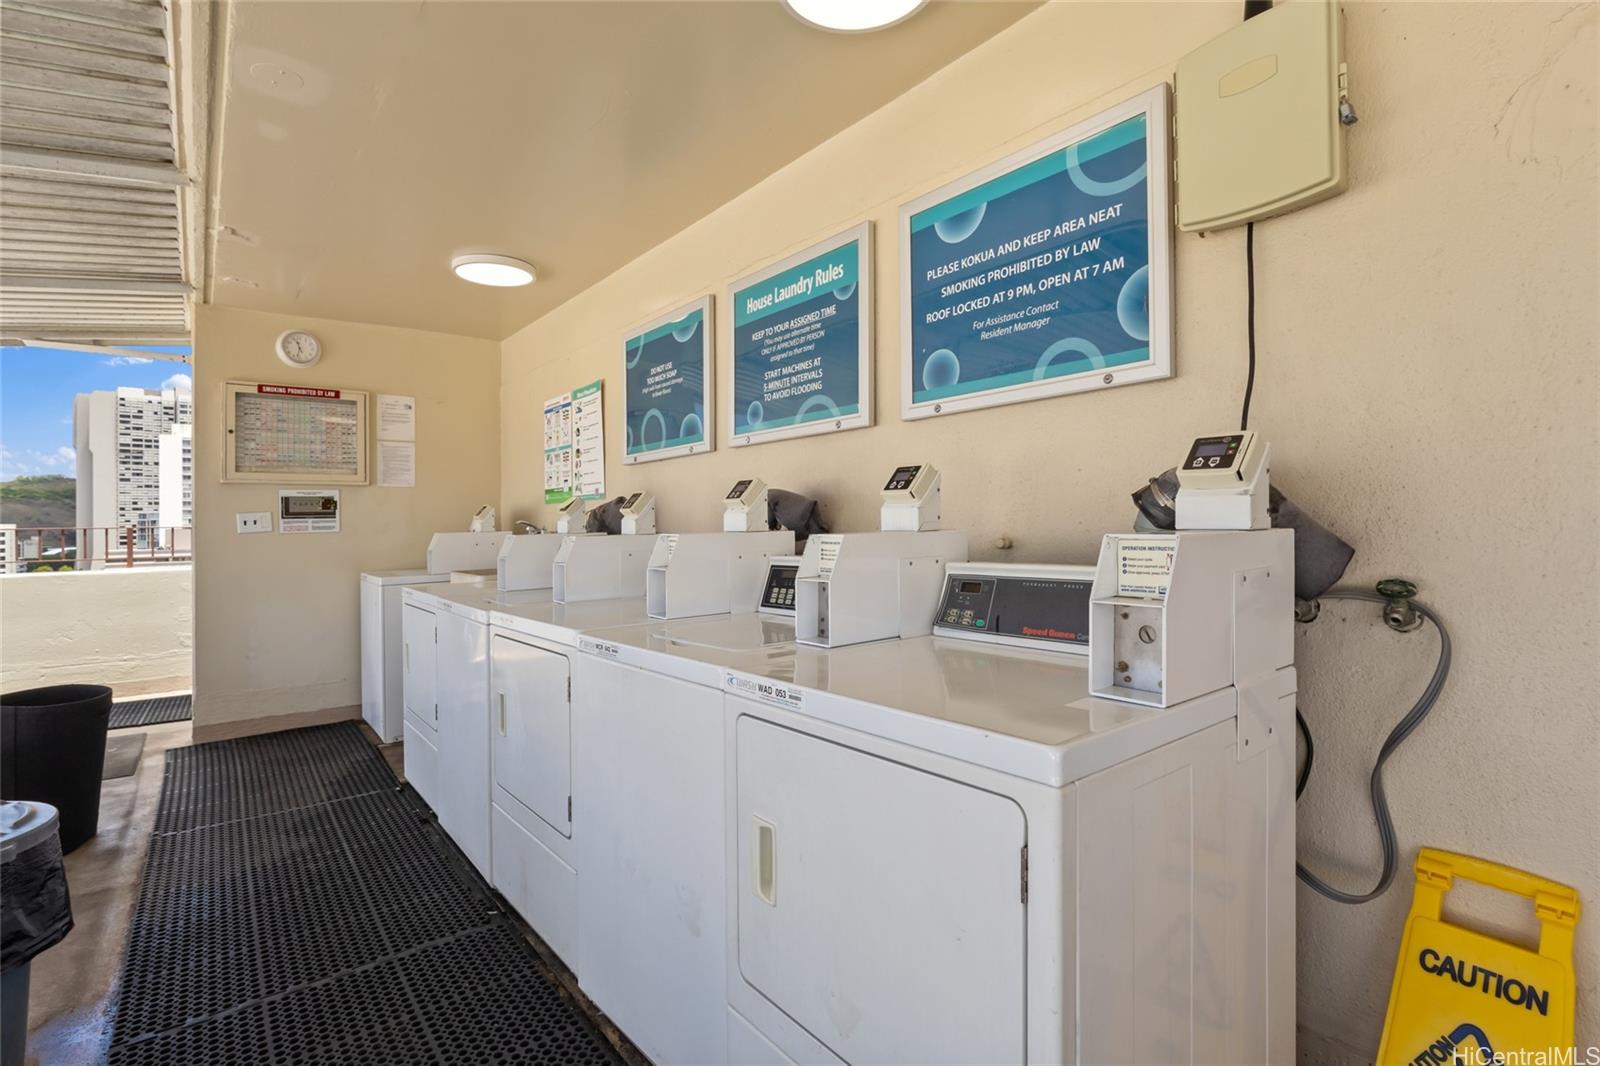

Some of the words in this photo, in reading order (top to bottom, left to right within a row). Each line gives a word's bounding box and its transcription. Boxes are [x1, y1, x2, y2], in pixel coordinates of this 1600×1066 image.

[927, 260, 960, 281] PLEASE
[961, 248, 996, 269] KOKUA
[997, 239, 1021, 257] AND
[1023, 228, 1052, 248] KEEP
[1053, 217, 1086, 237] AREA
[1088, 203, 1123, 226] NEAT
[941, 274, 986, 298] SMOKING
[987, 253, 1053, 283] PROHIBITED
[1055, 246, 1071, 262] BY
[1072, 237, 1101, 256] LAW
[746, 293, 774, 315] House
[774, 276, 814, 304] Laundry
[815, 263, 844, 287] Rules
[926, 307, 951, 324] ROOF
[952, 296, 991, 317] LOCKED
[992, 291, 1006, 305] AT
[1007, 289, 1014, 300] 9
[1016, 283, 1036, 298] PM,
[1038, 272, 1071, 291] OPEN
[1073, 266, 1090, 282] AT
[1092, 264, 1100, 277] 7
[1102, 256, 1125, 274] AM
[752, 330, 766, 341] KEEP
[765, 327, 774, 337] TO
[773, 321, 790, 333] YOUR
[790, 310, 821, 328] ASSIGNED
[820, 304, 837, 318] TIME
[972, 320, 986, 331] For
[985, 310, 1025, 327] Assistance
[1025, 300, 1060, 316] Contact
[806, 330, 826, 341] PERSON
[980, 325, 1013, 341] Resident
[1013, 316, 1051, 334] Manager
[763, 378, 790, 393] 5-MINUTE
[790, 368, 824, 384] INTERVALS
[764, 370, 782, 381] START
[782, 359, 813, 376] MACHINES
[813, 357, 822, 367] AT
[262, 385, 287, 393] SMOKING
[287, 388, 317, 396] PROHIBITED
[764, 392, 772, 402] TO
[772, 388, 791, 400] AVOID
[791, 380, 823, 396] FLOODING
[1023, 626, 1048, 636] Speed
[1048, 628, 1076, 640] Queen
[757, 683, 773, 695] WAD
[774, 688, 787, 699] 053
[1418, 948, 1549, 1016] CAUTION
